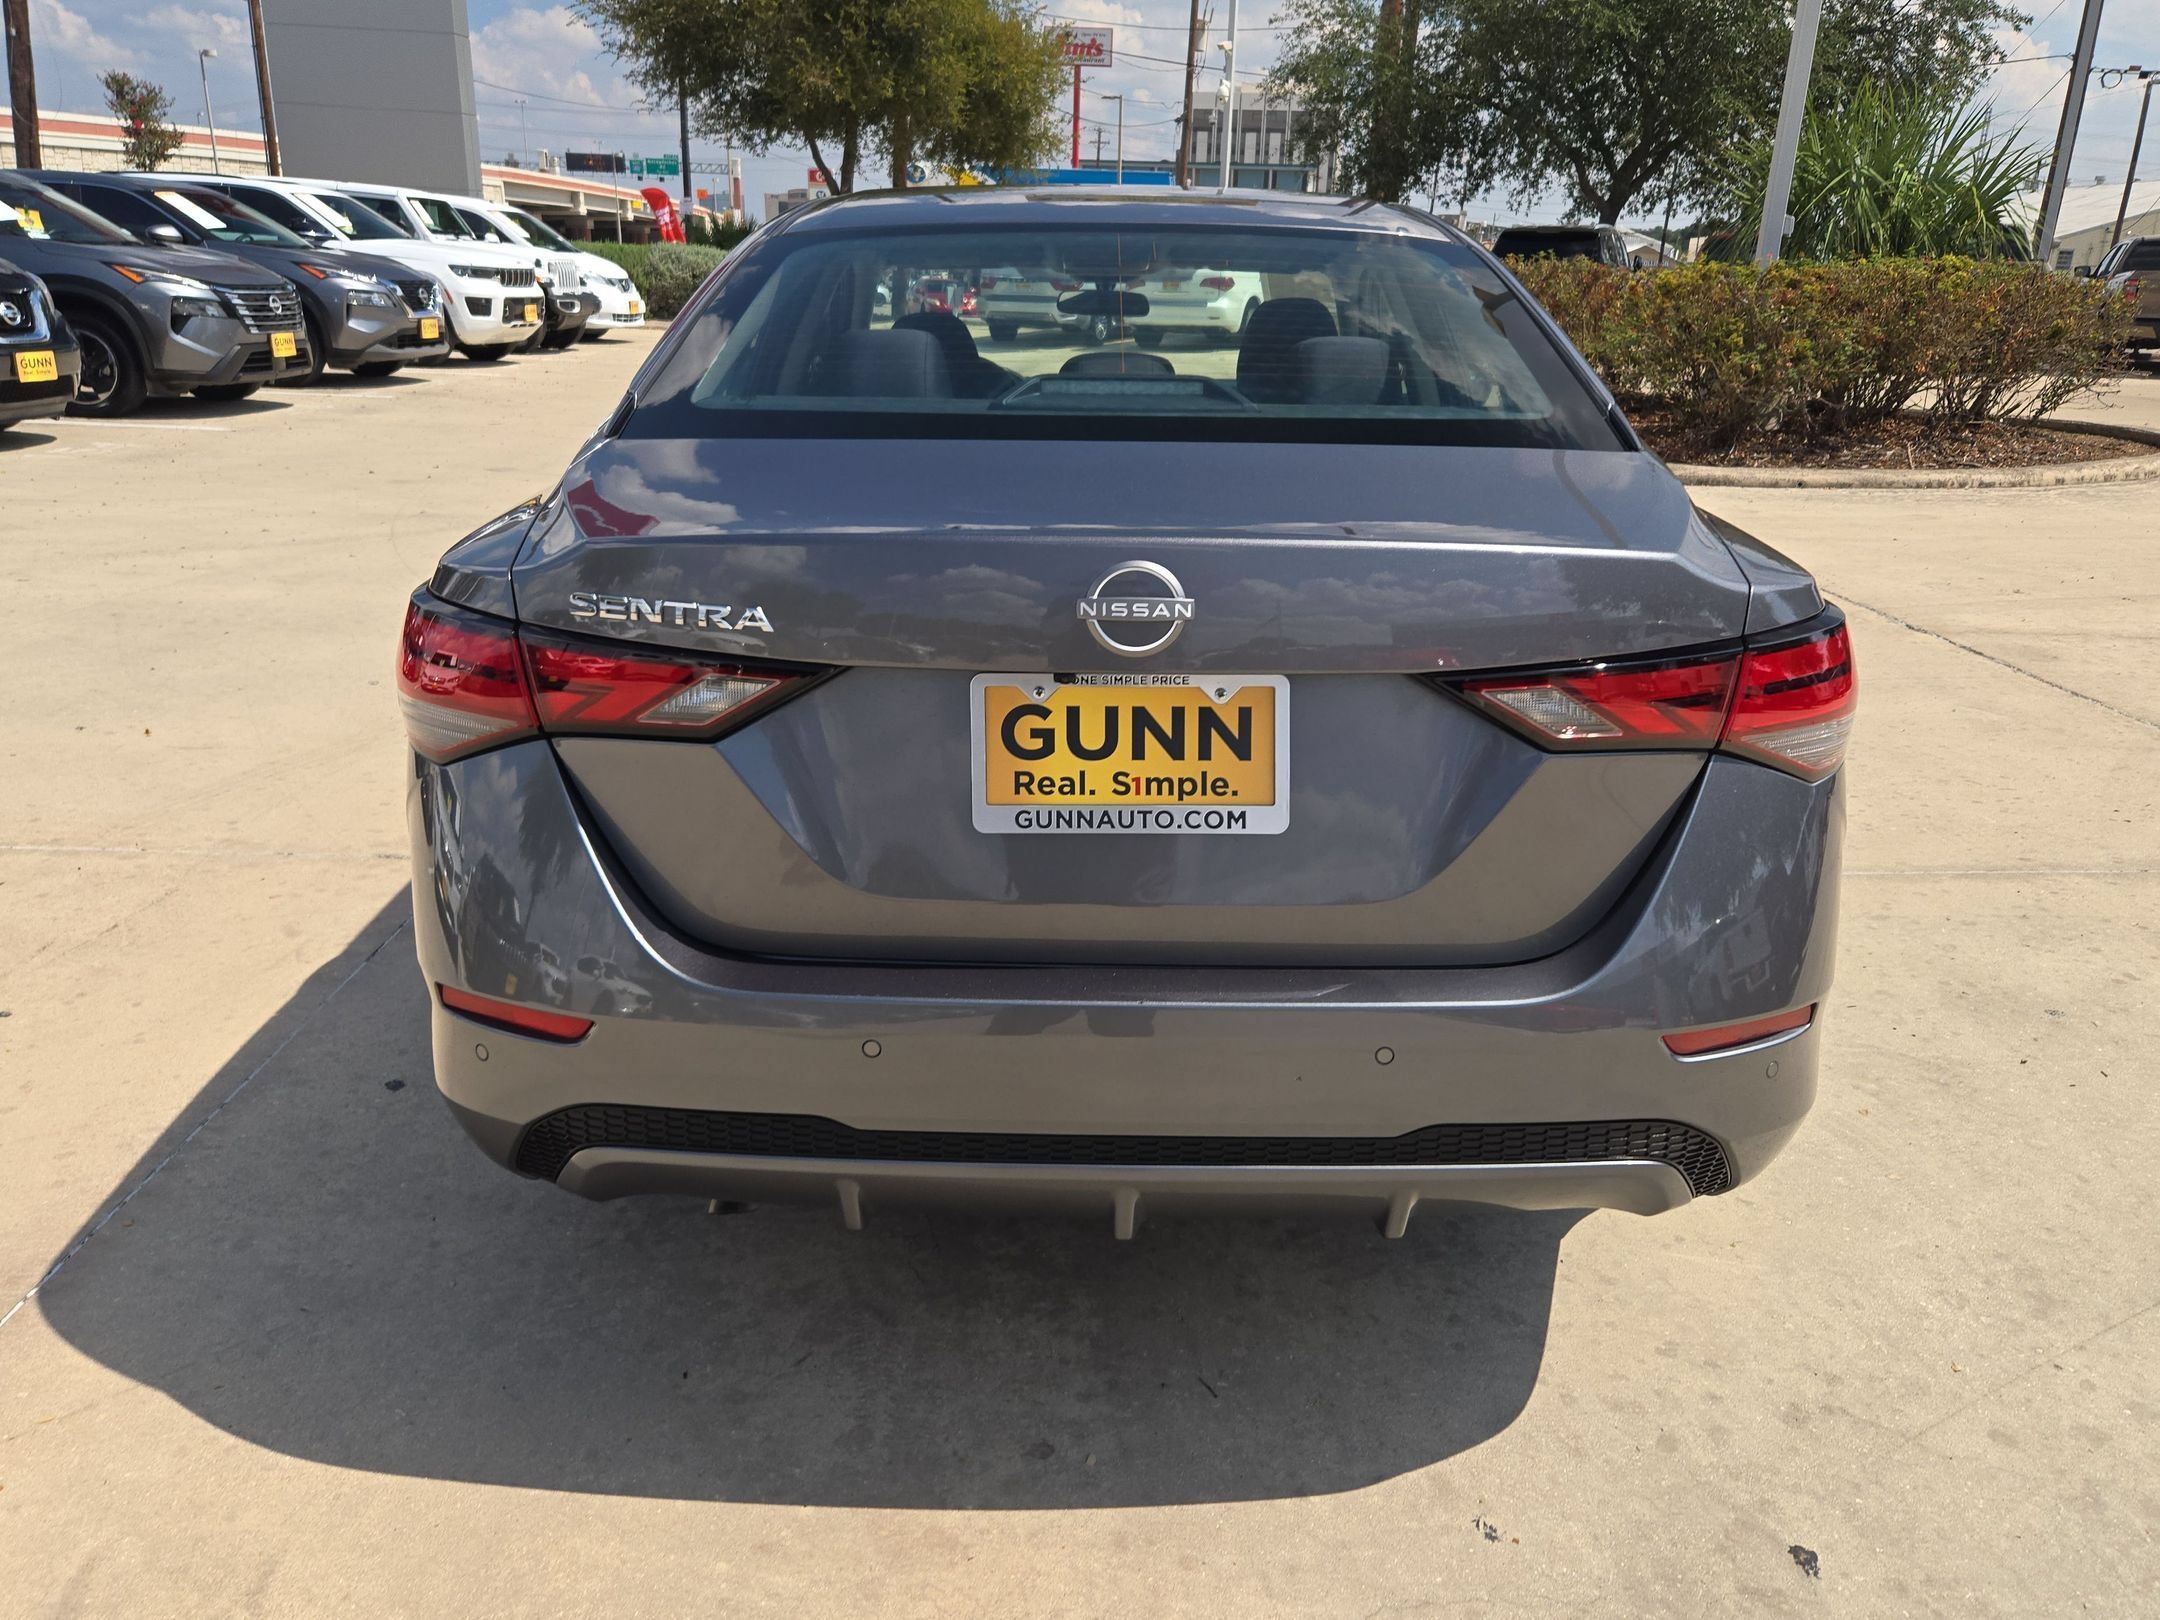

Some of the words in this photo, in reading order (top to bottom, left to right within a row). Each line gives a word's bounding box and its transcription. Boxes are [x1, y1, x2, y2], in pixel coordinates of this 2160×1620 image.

[20, 356, 52, 369] GUNN
[569, 592, 774, 632] SENTRA
[1080, 602, 1192, 618] NISSAN
[1101, 675, 1148, 685] SIMPLE
[1151, 675, 1190, 685] PRICE
[1000, 703, 1252, 761] GUNN
[1013, 771, 1096, 796] Real.
[1014, 810, 1247, 829] GUNNAUTO.COM
